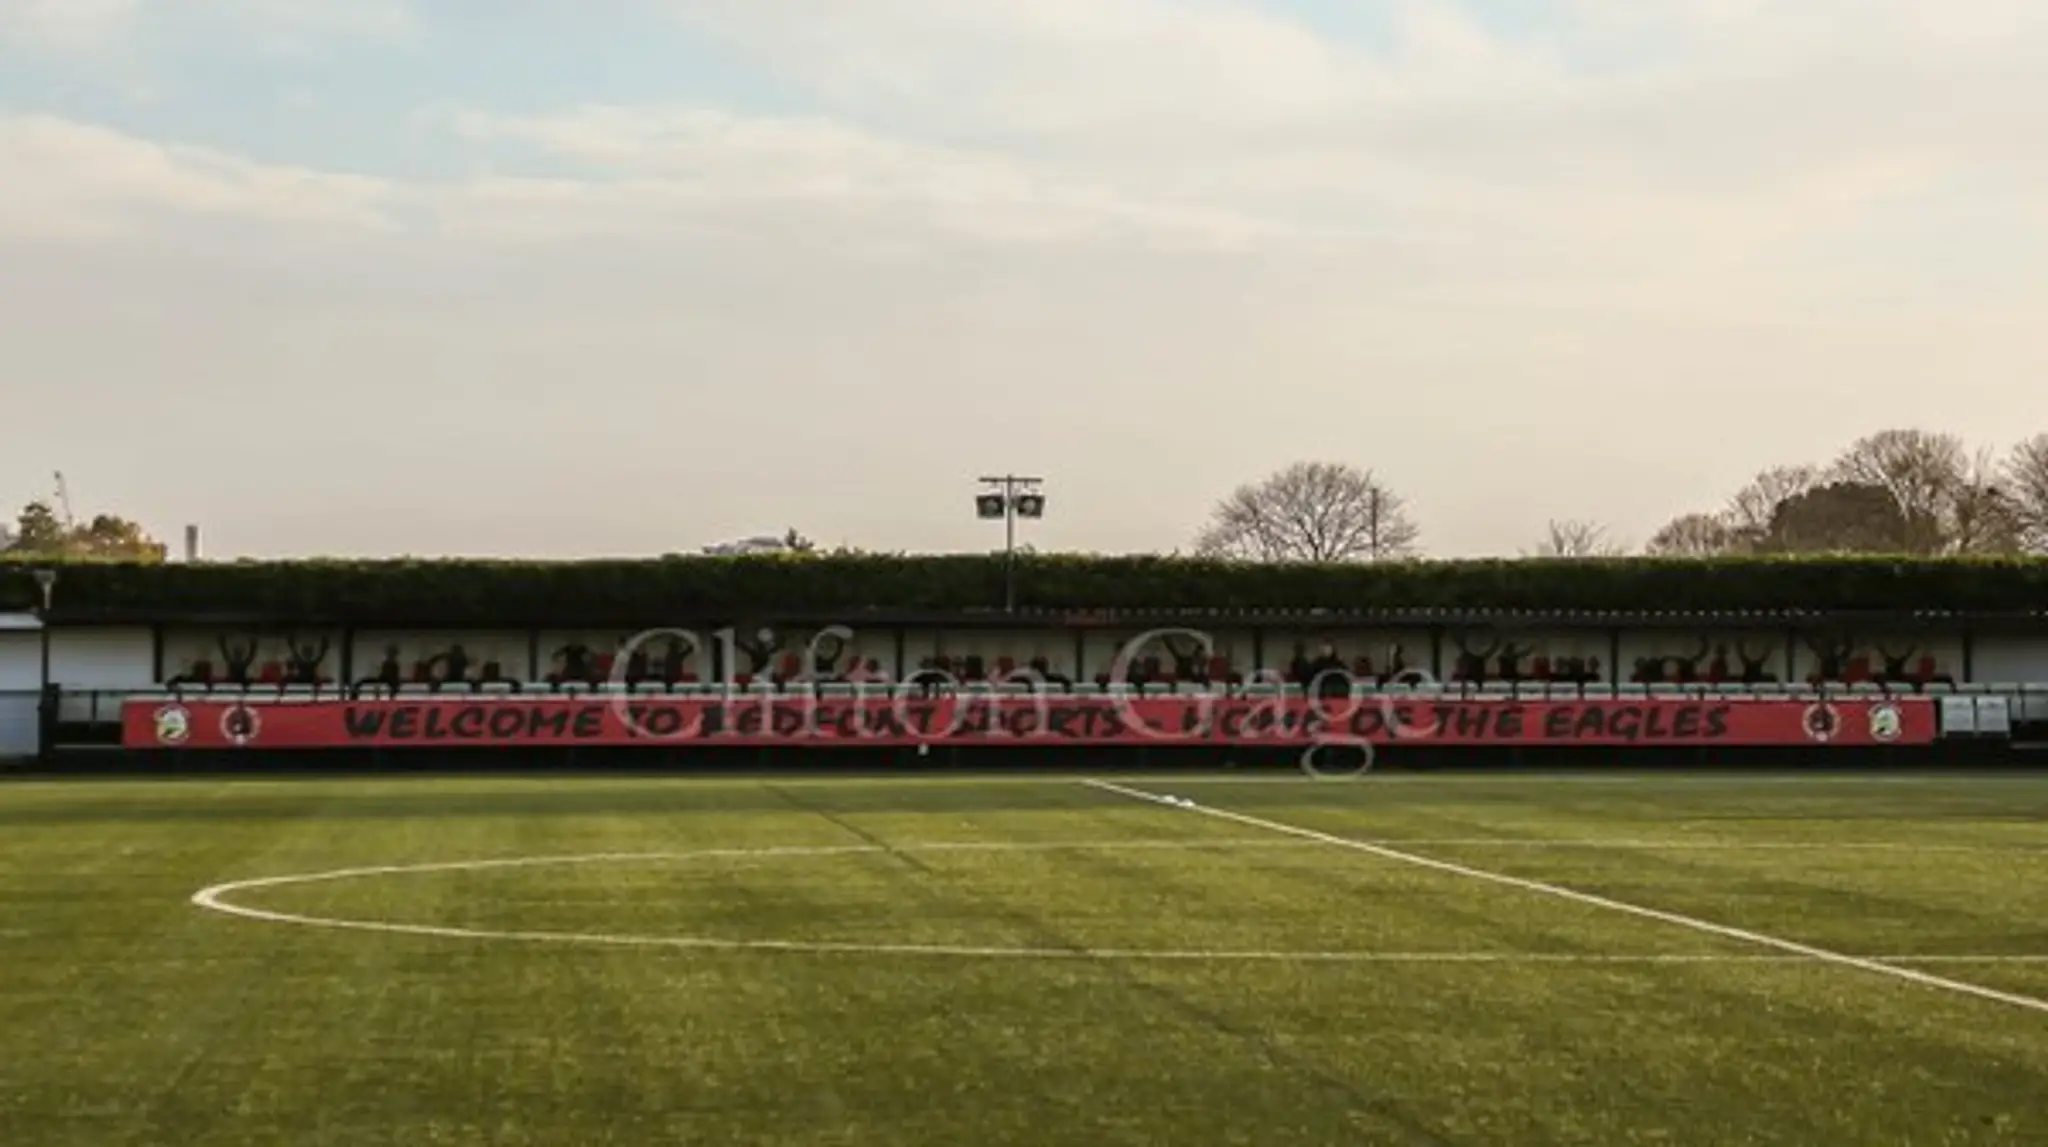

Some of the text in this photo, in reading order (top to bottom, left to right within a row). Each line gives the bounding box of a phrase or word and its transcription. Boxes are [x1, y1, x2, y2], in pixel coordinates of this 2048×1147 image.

[343, 705, 605, 739] WELCOME
[627, 706, 683, 737] TO
[702, 705, 938, 738] BEDFONT
[954, 705, 1127, 739] SPORTS
[1183, 705, 1334, 738] HOME
[1349, 706, 1417, 739] OF
[1433, 705, 1528, 739] THE
[1543, 705, 1730, 740] EAGLES
